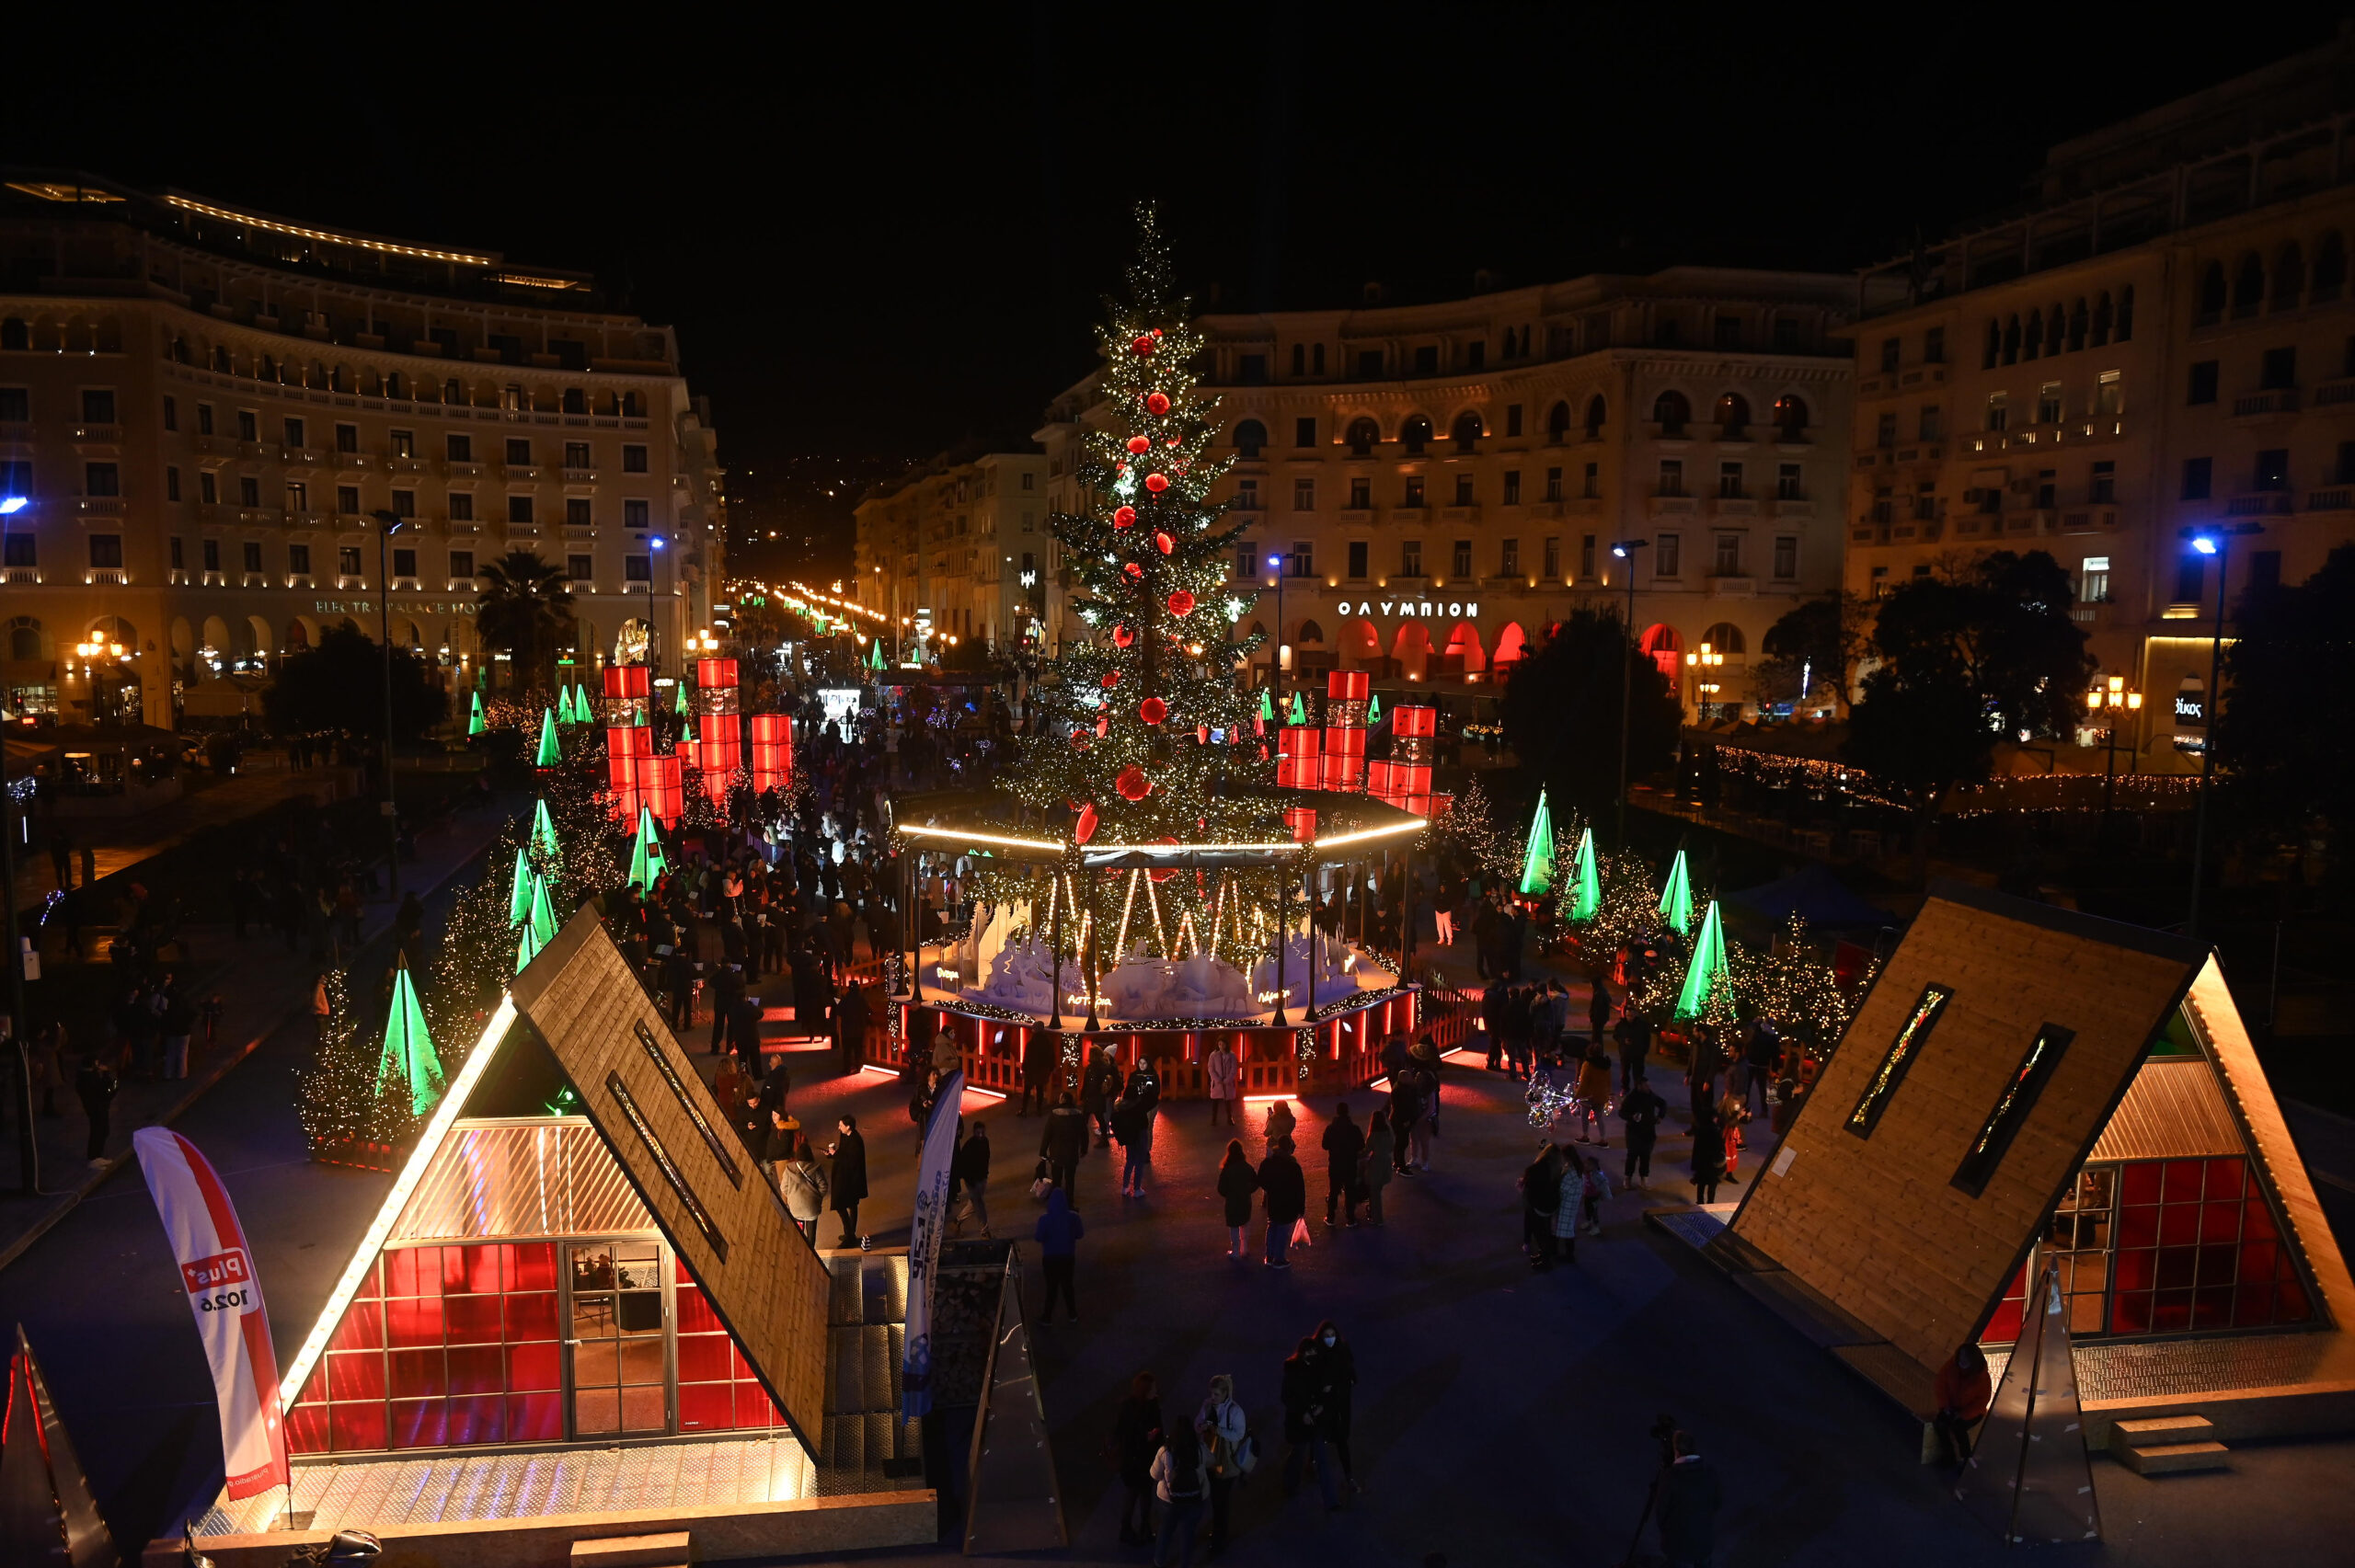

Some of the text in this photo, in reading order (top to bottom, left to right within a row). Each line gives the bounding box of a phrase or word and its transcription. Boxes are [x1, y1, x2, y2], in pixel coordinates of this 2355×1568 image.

[316, 601, 486, 614] ELECTRA PALACE HOT
[1338, 601, 1478, 617] ΟΛΥΜΠΙΟΝ
